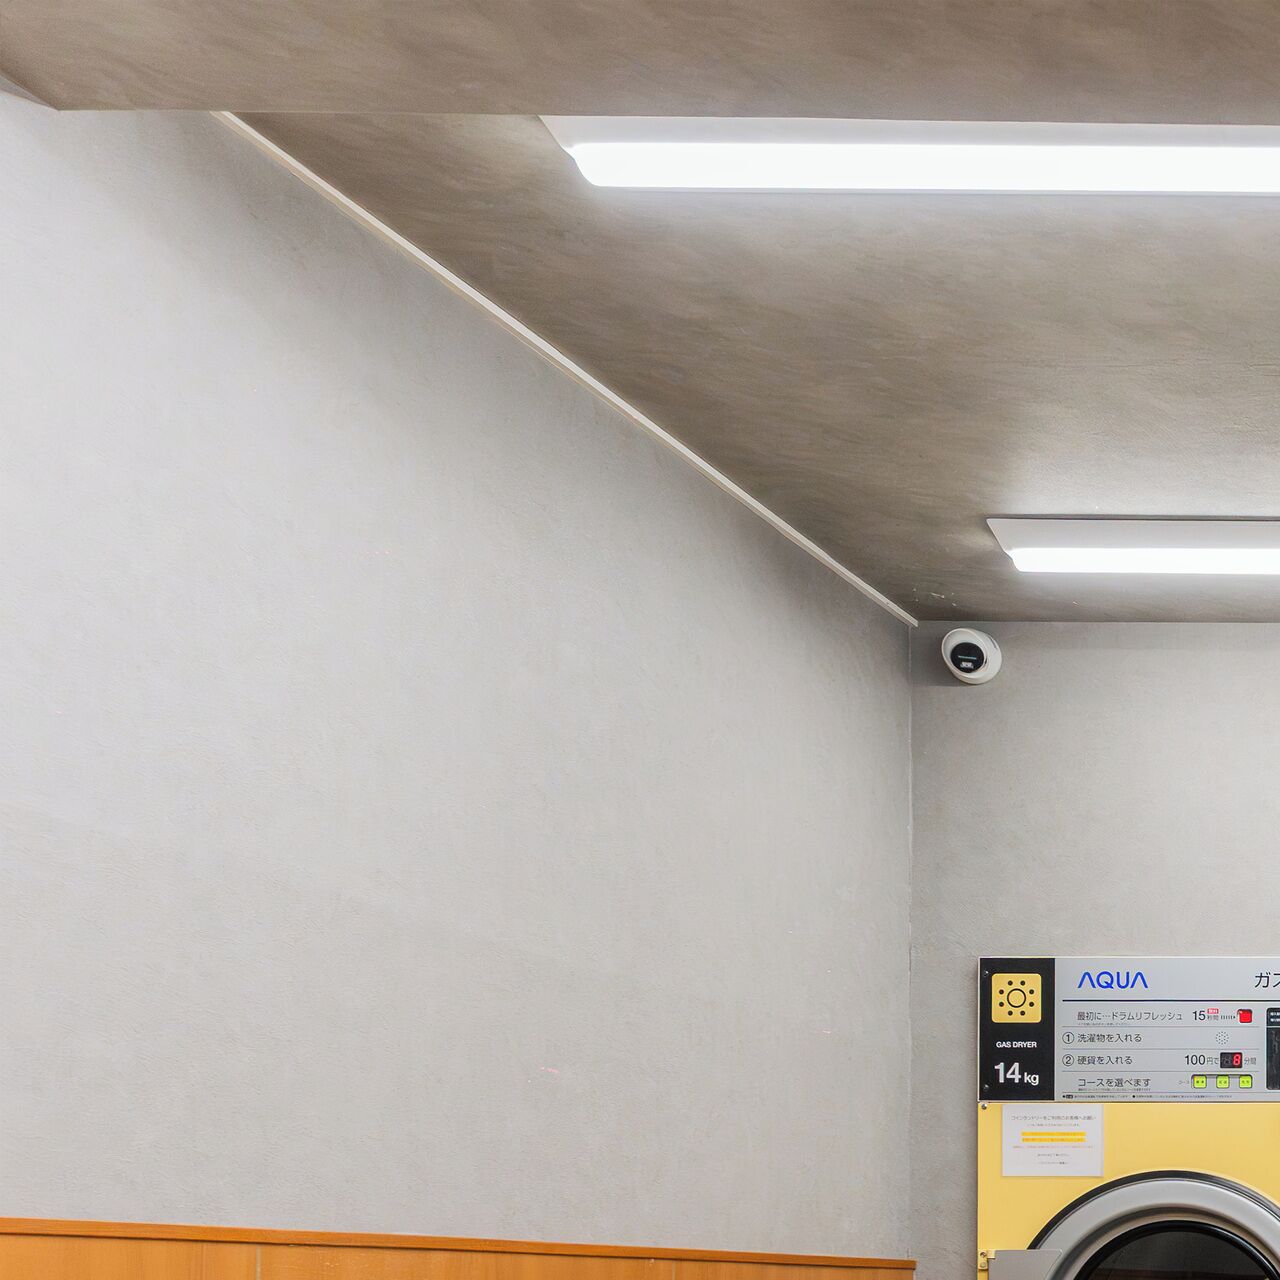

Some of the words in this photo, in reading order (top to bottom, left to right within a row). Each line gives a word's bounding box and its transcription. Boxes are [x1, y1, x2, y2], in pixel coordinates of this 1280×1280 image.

[1077, 970, 1149, 990] AQUA
[1077, 1032, 1142, 1044] 洗濯物を入れる
[1077, 1054, 1133, 1066] 硬貨を入れる
[1077, 1076, 1151, 1089] コースを選べます
